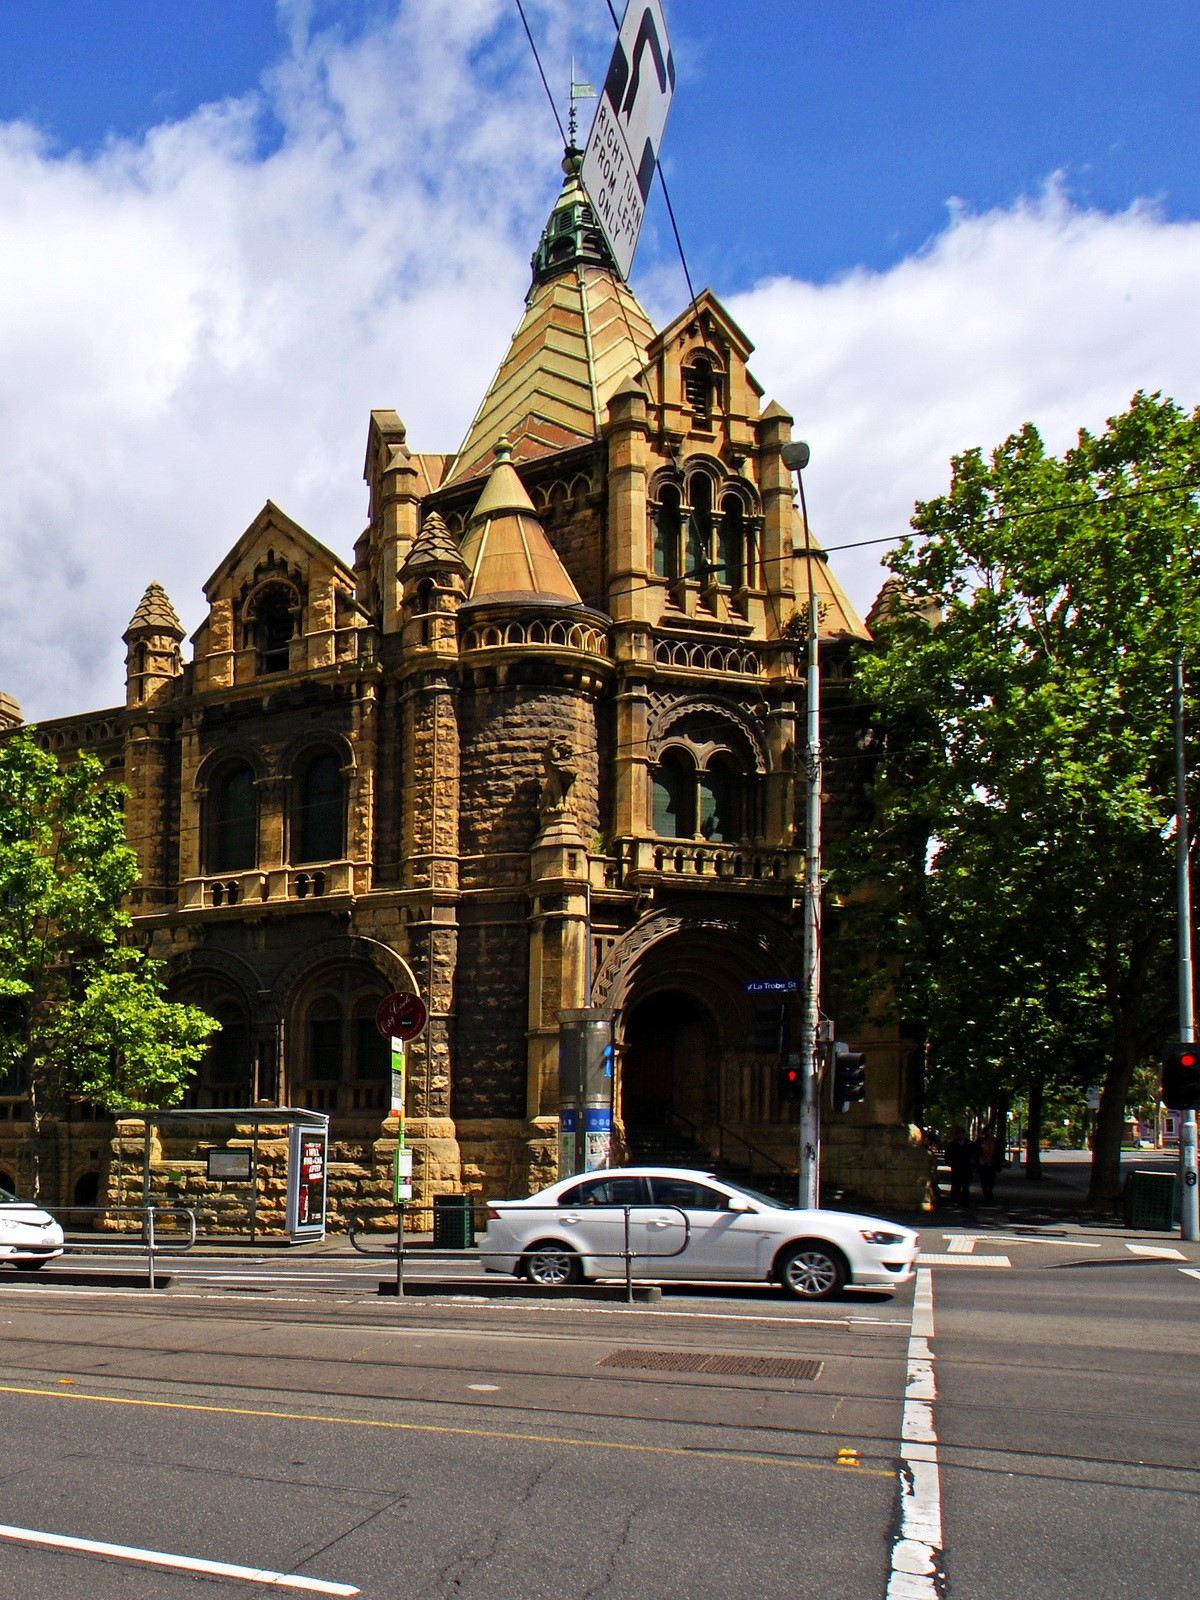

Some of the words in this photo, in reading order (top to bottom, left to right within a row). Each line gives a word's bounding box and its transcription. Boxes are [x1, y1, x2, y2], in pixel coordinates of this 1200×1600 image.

[592, 134, 616, 193] FROM
[617, 195, 636, 246] LEFT
[597, 105, 624, 172] RIGHT
[623, 170, 642, 230] TURN
[597, 189, 621, 243] ONLY
